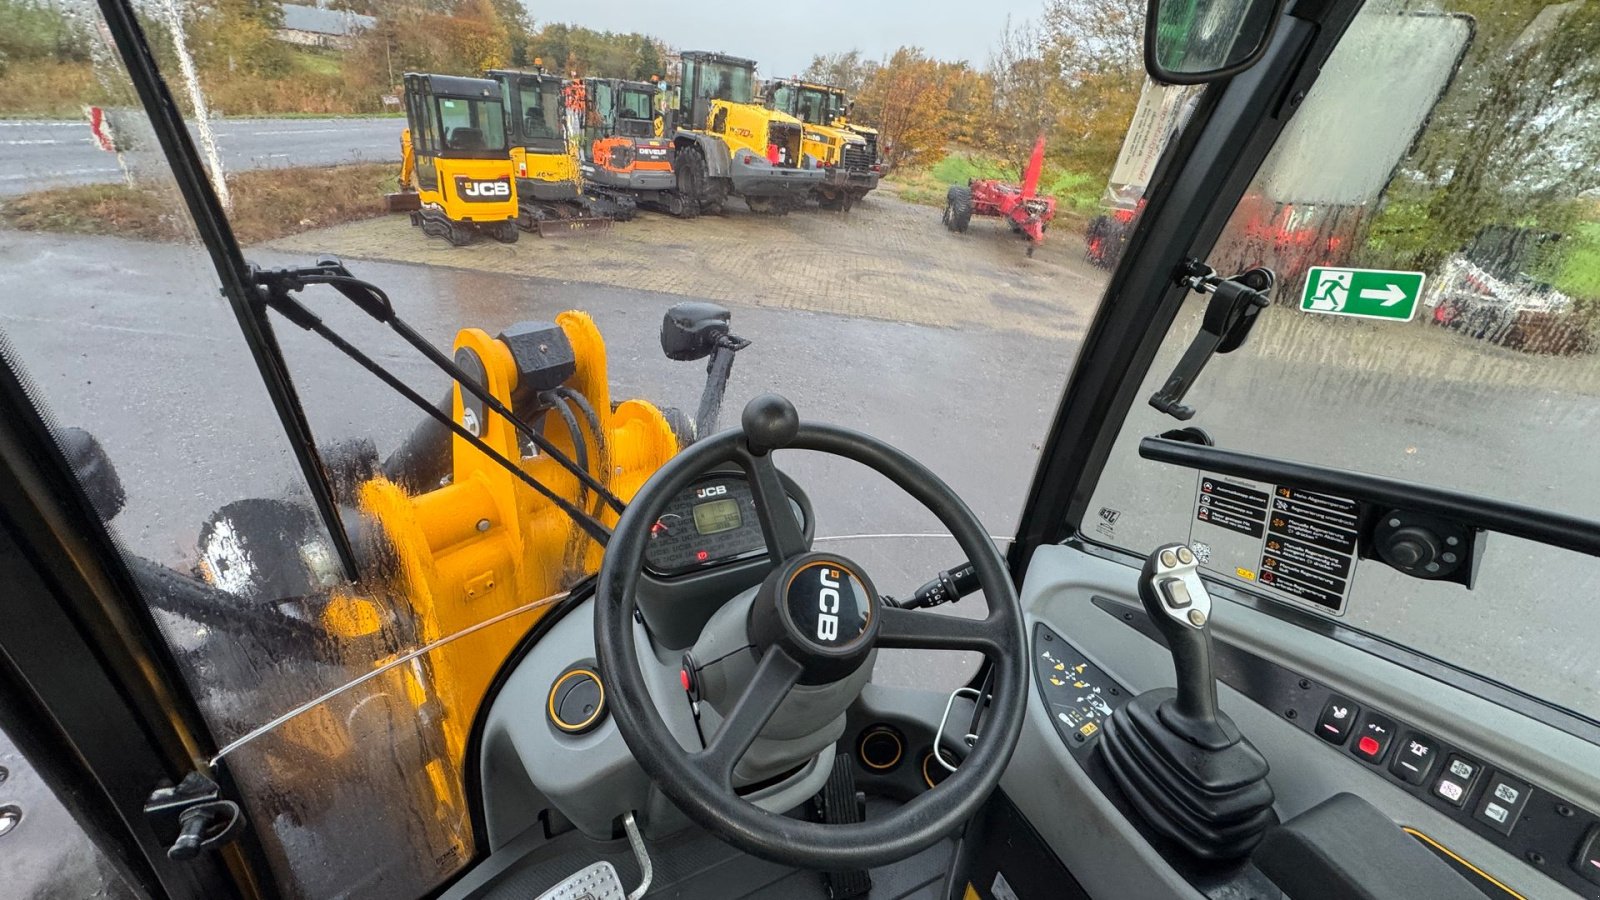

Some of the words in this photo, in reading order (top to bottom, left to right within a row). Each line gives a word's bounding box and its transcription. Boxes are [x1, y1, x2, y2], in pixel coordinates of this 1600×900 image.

[465, 181, 510, 196] JCB
[697, 485, 727, 498] JCB
[817, 568, 840, 641] JCB
